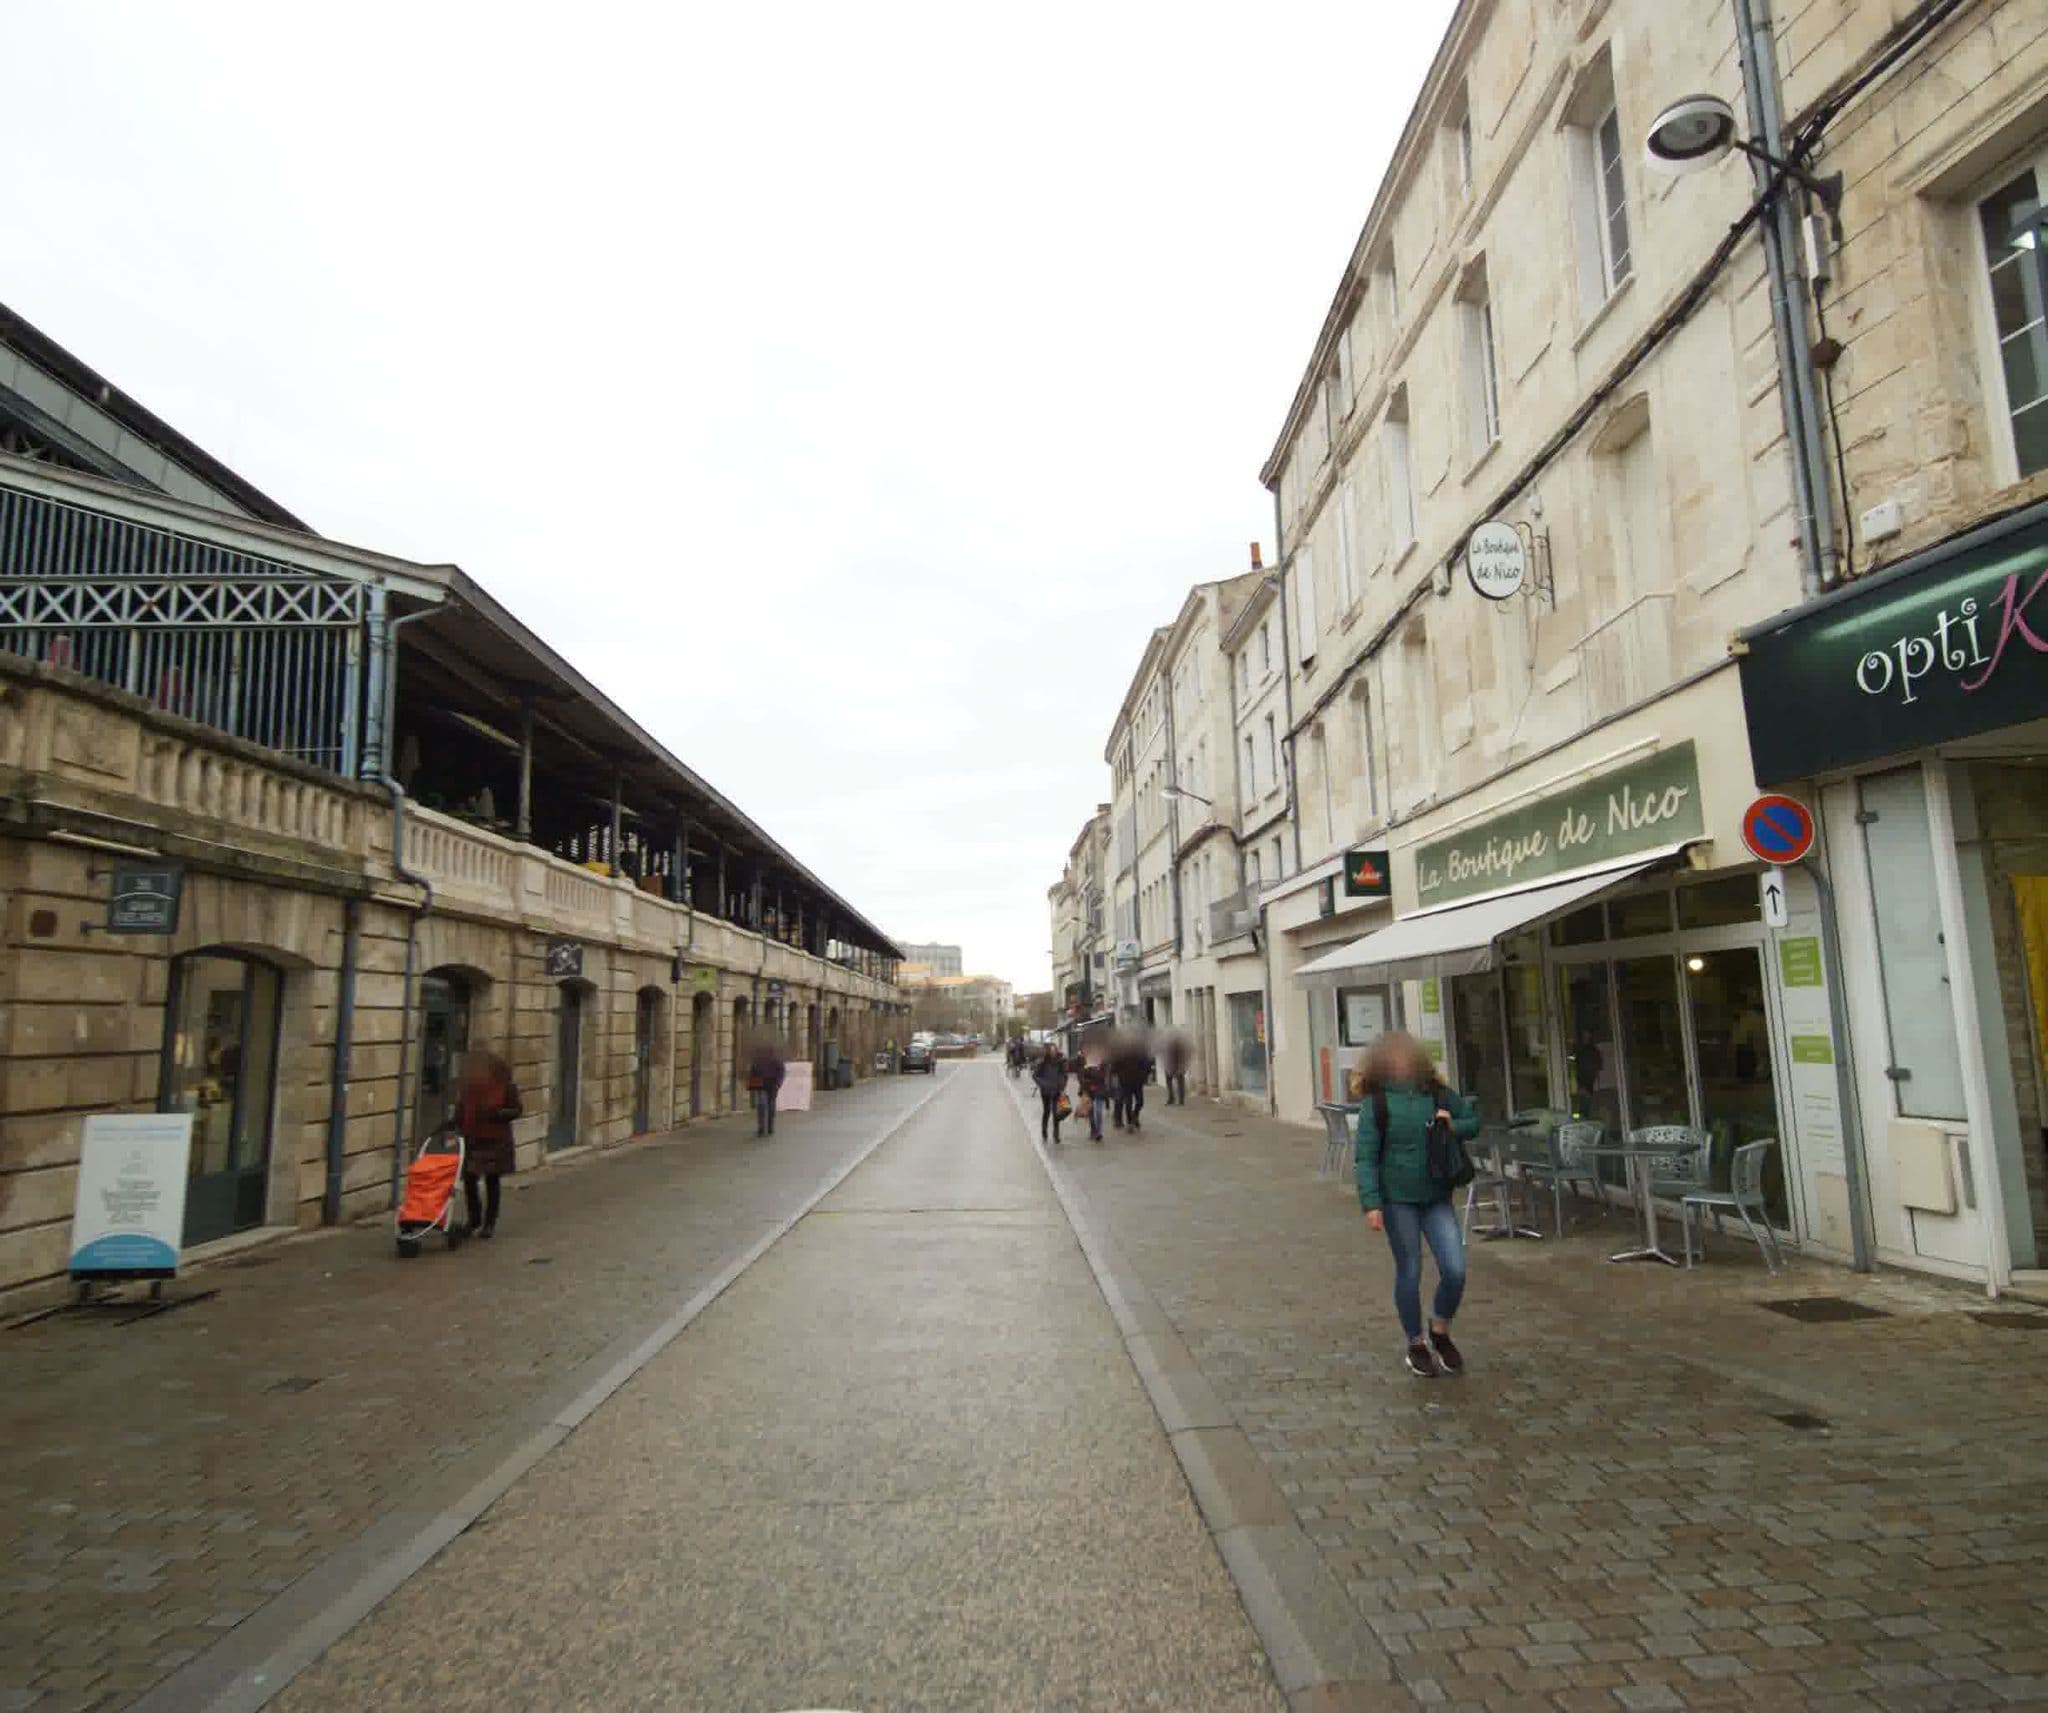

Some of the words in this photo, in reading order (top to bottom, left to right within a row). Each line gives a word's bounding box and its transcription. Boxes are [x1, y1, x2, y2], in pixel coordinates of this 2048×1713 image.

[1419, 862, 1441, 892] La
[1449, 829, 1550, 878] Boutique
[1559, 806, 1596, 849] de
[1607, 783, 1690, 836] Nico
